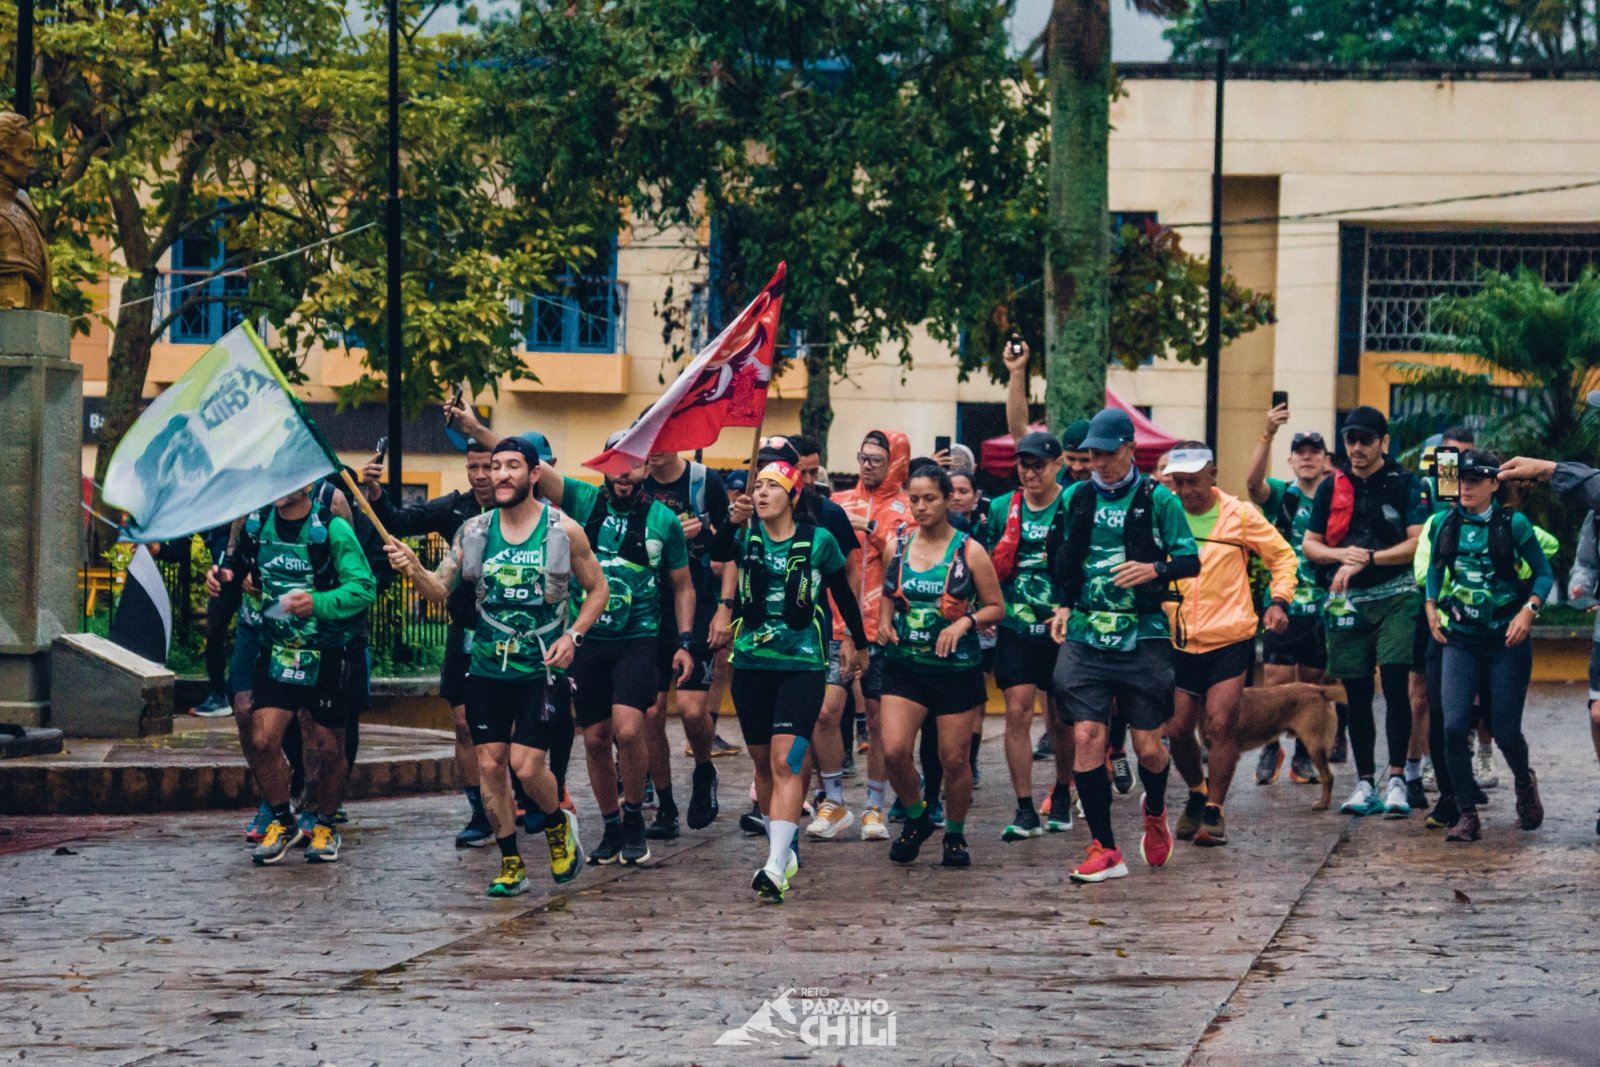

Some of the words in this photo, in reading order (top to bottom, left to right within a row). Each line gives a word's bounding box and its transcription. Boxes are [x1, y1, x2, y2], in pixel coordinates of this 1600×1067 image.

[1108, 509, 1127, 517] PARA
[503, 588, 528, 599] 30
[909, 630, 931, 641] 24
[1100, 635, 1122, 646] 47
[282, 668, 305, 680] 28
